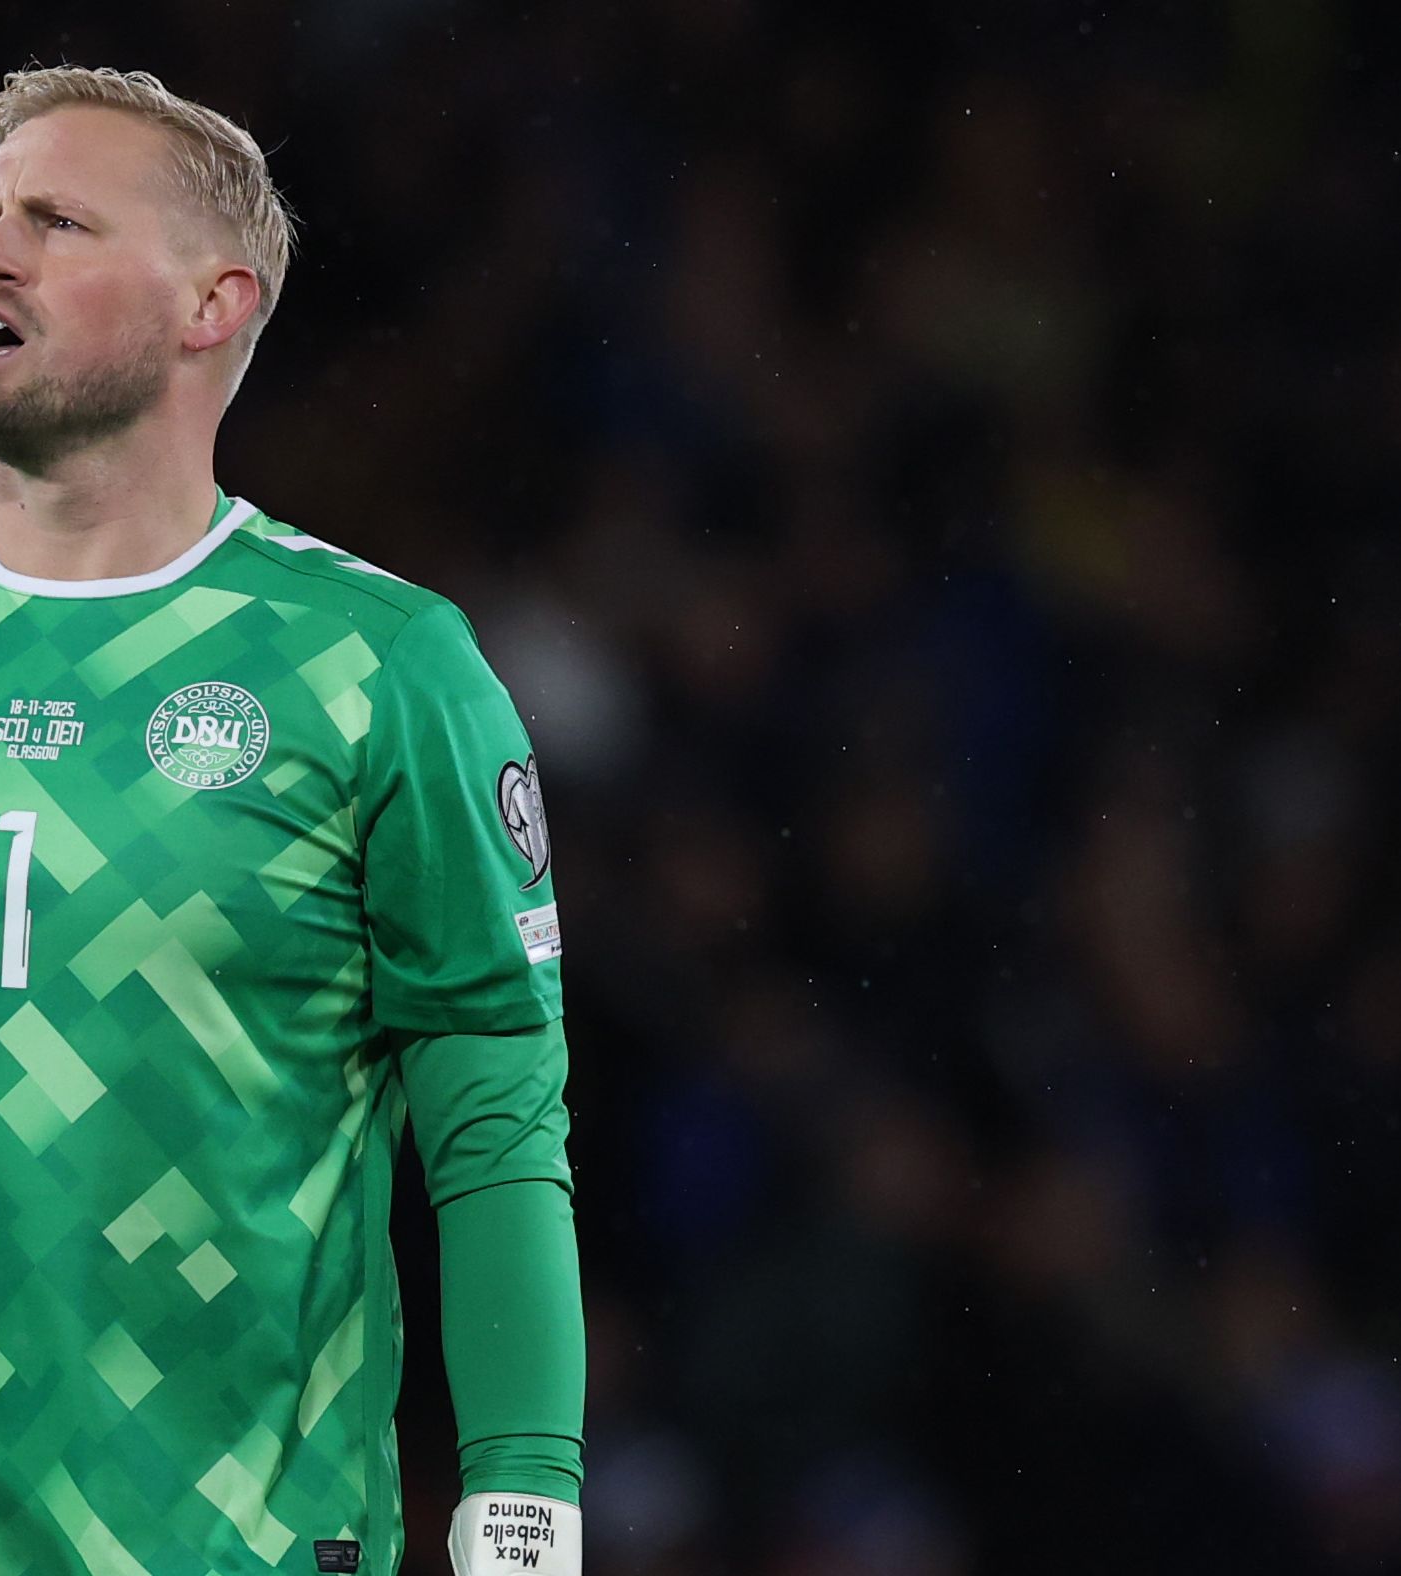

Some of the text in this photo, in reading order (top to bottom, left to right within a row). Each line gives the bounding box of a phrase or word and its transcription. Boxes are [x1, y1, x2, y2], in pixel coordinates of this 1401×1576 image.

[9, 699, 77, 718] 18-11-2025
[45, 719, 85, 746] DEN
[151, 707, 174, 770] DANSK
[170, 715, 245, 749] DBU
[6, 743, 60, 761] GLASGOW
[176, 767, 226, 786] 1889
[488, 1502, 552, 1527] Nanna
[482, 1523, 555, 1548] Isabella
[494, 1546, 540, 1568] Max
